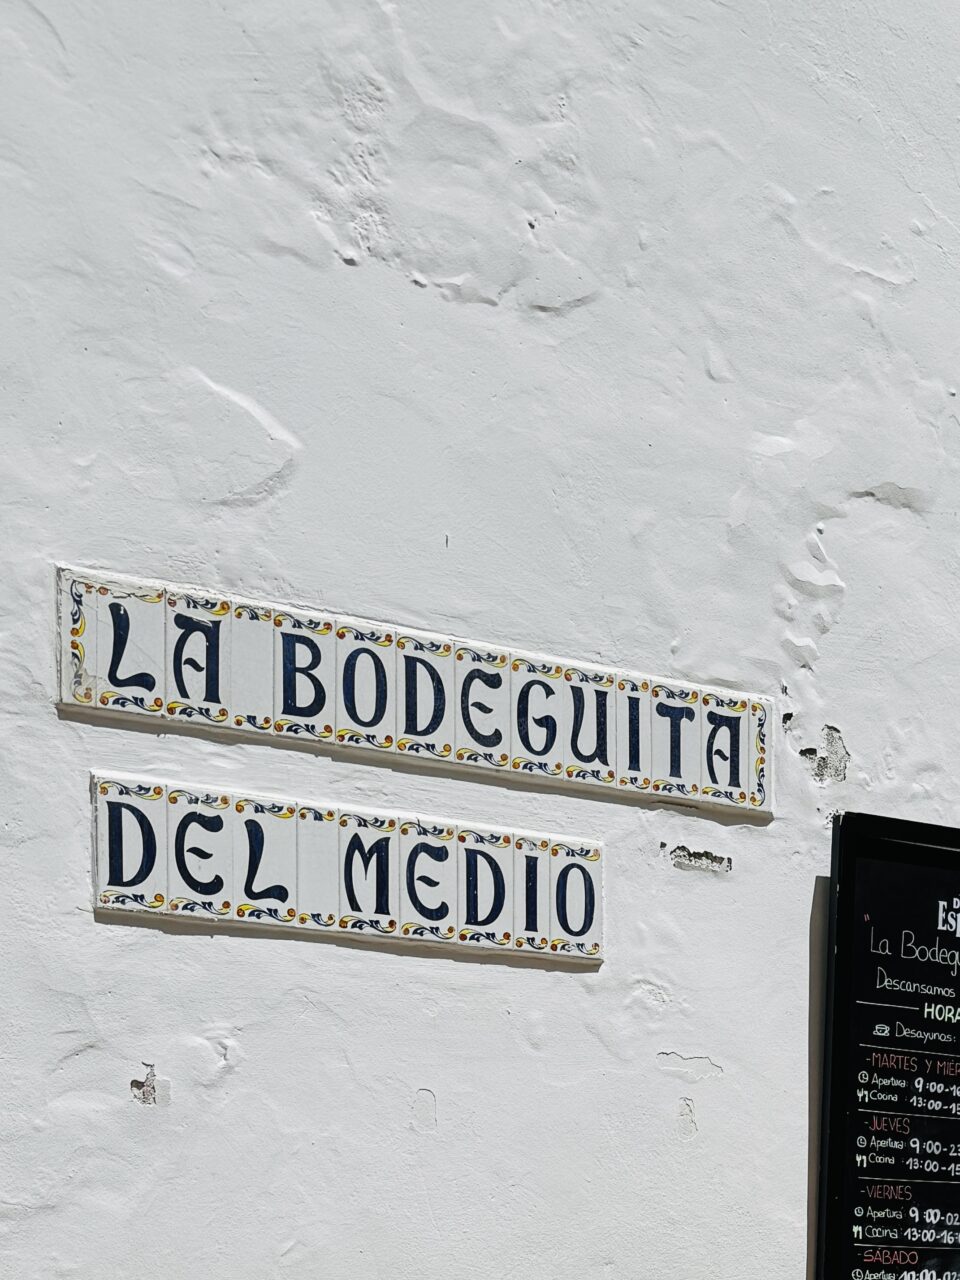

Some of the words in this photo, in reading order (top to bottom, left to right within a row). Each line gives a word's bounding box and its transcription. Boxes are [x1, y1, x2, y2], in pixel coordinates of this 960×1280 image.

[107, 602, 222, 704] LA
[281, 631, 742, 789] BODEGUITA
[107, 800, 290, 904] DEL
[344, 836, 596, 938] MEDIO
[876, 966, 956, 998] Descansamos
[895, 1021, 956, 1044] Desayunos:
